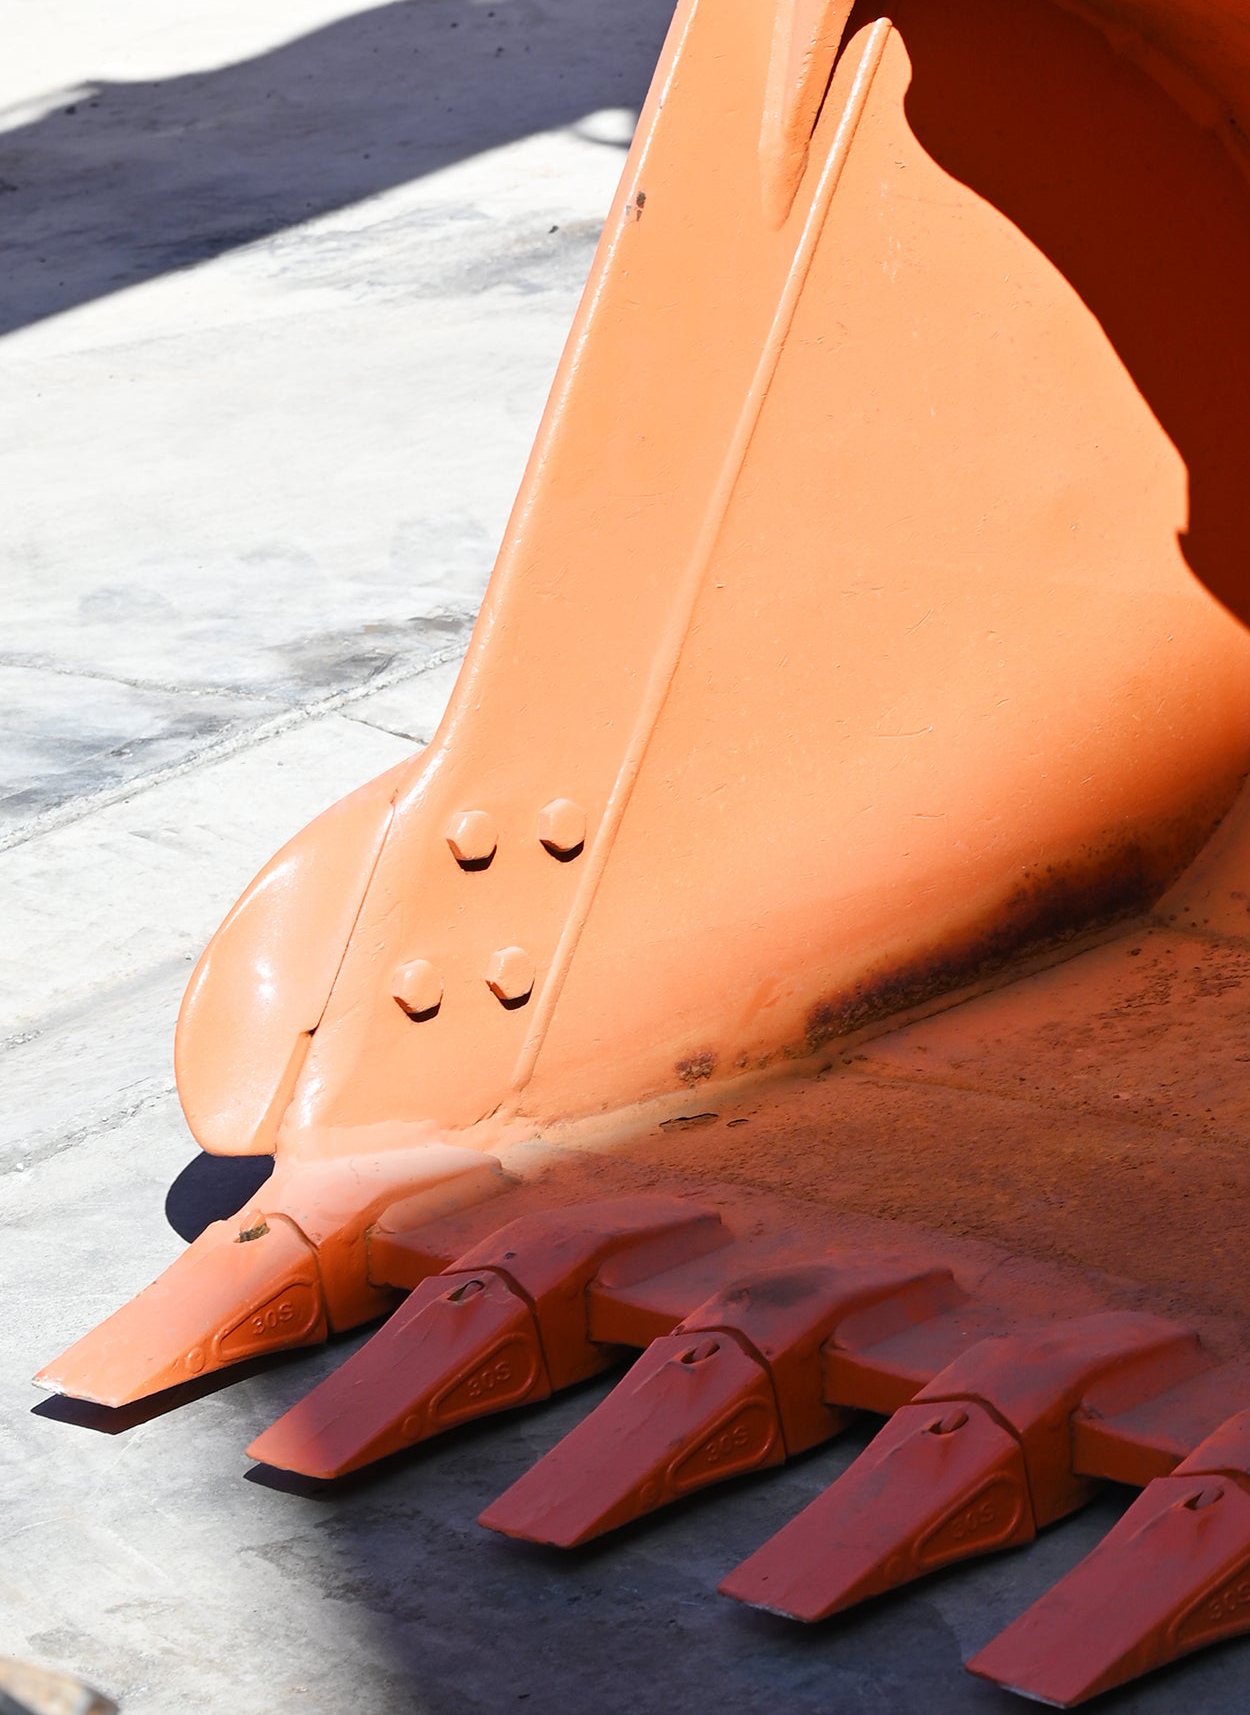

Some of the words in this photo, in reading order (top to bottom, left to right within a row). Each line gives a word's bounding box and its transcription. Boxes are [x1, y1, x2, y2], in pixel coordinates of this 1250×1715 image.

[251, 1302, 293, 1335] 30S
[466, 1360, 511, 1397] 30S
[705, 1425, 748, 1462] 30S
